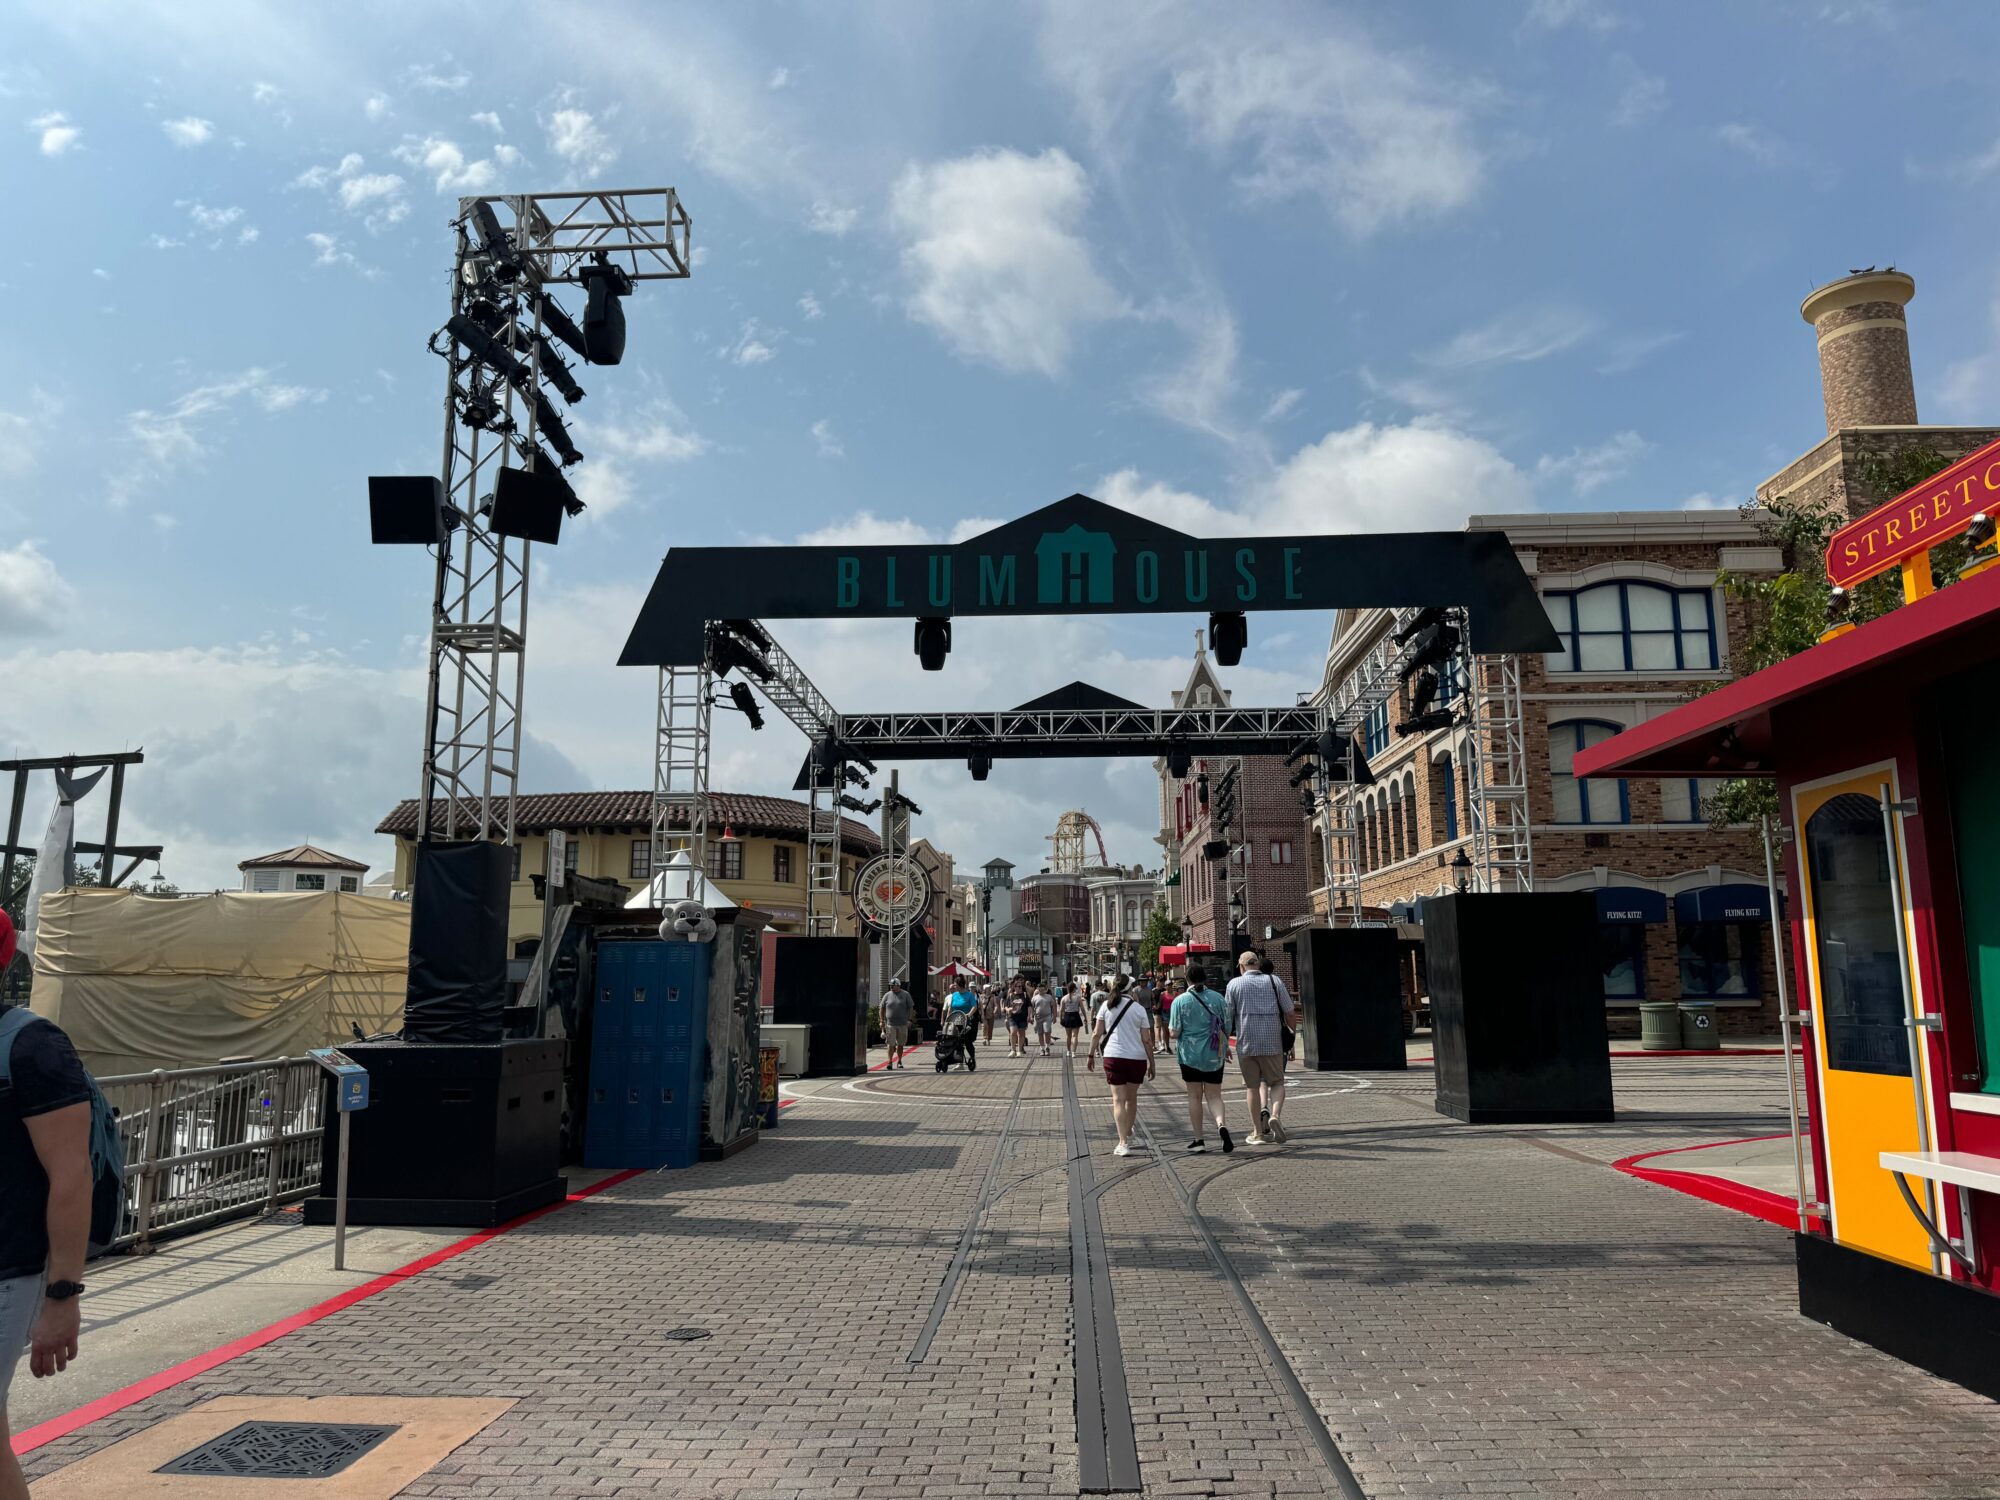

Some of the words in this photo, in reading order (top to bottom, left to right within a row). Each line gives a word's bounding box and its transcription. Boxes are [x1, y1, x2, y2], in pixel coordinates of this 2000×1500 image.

[837, 540, 1303, 608] BLUMHOUSE
[863, 862, 903, 892] FISHERMS
[1606, 911, 1627, 919] FLYING
[1627, 911, 1642, 919] KITZ!
[1725, 908, 1745, 917] FLYING
[1745, 908, 1761, 917] KITZ!
